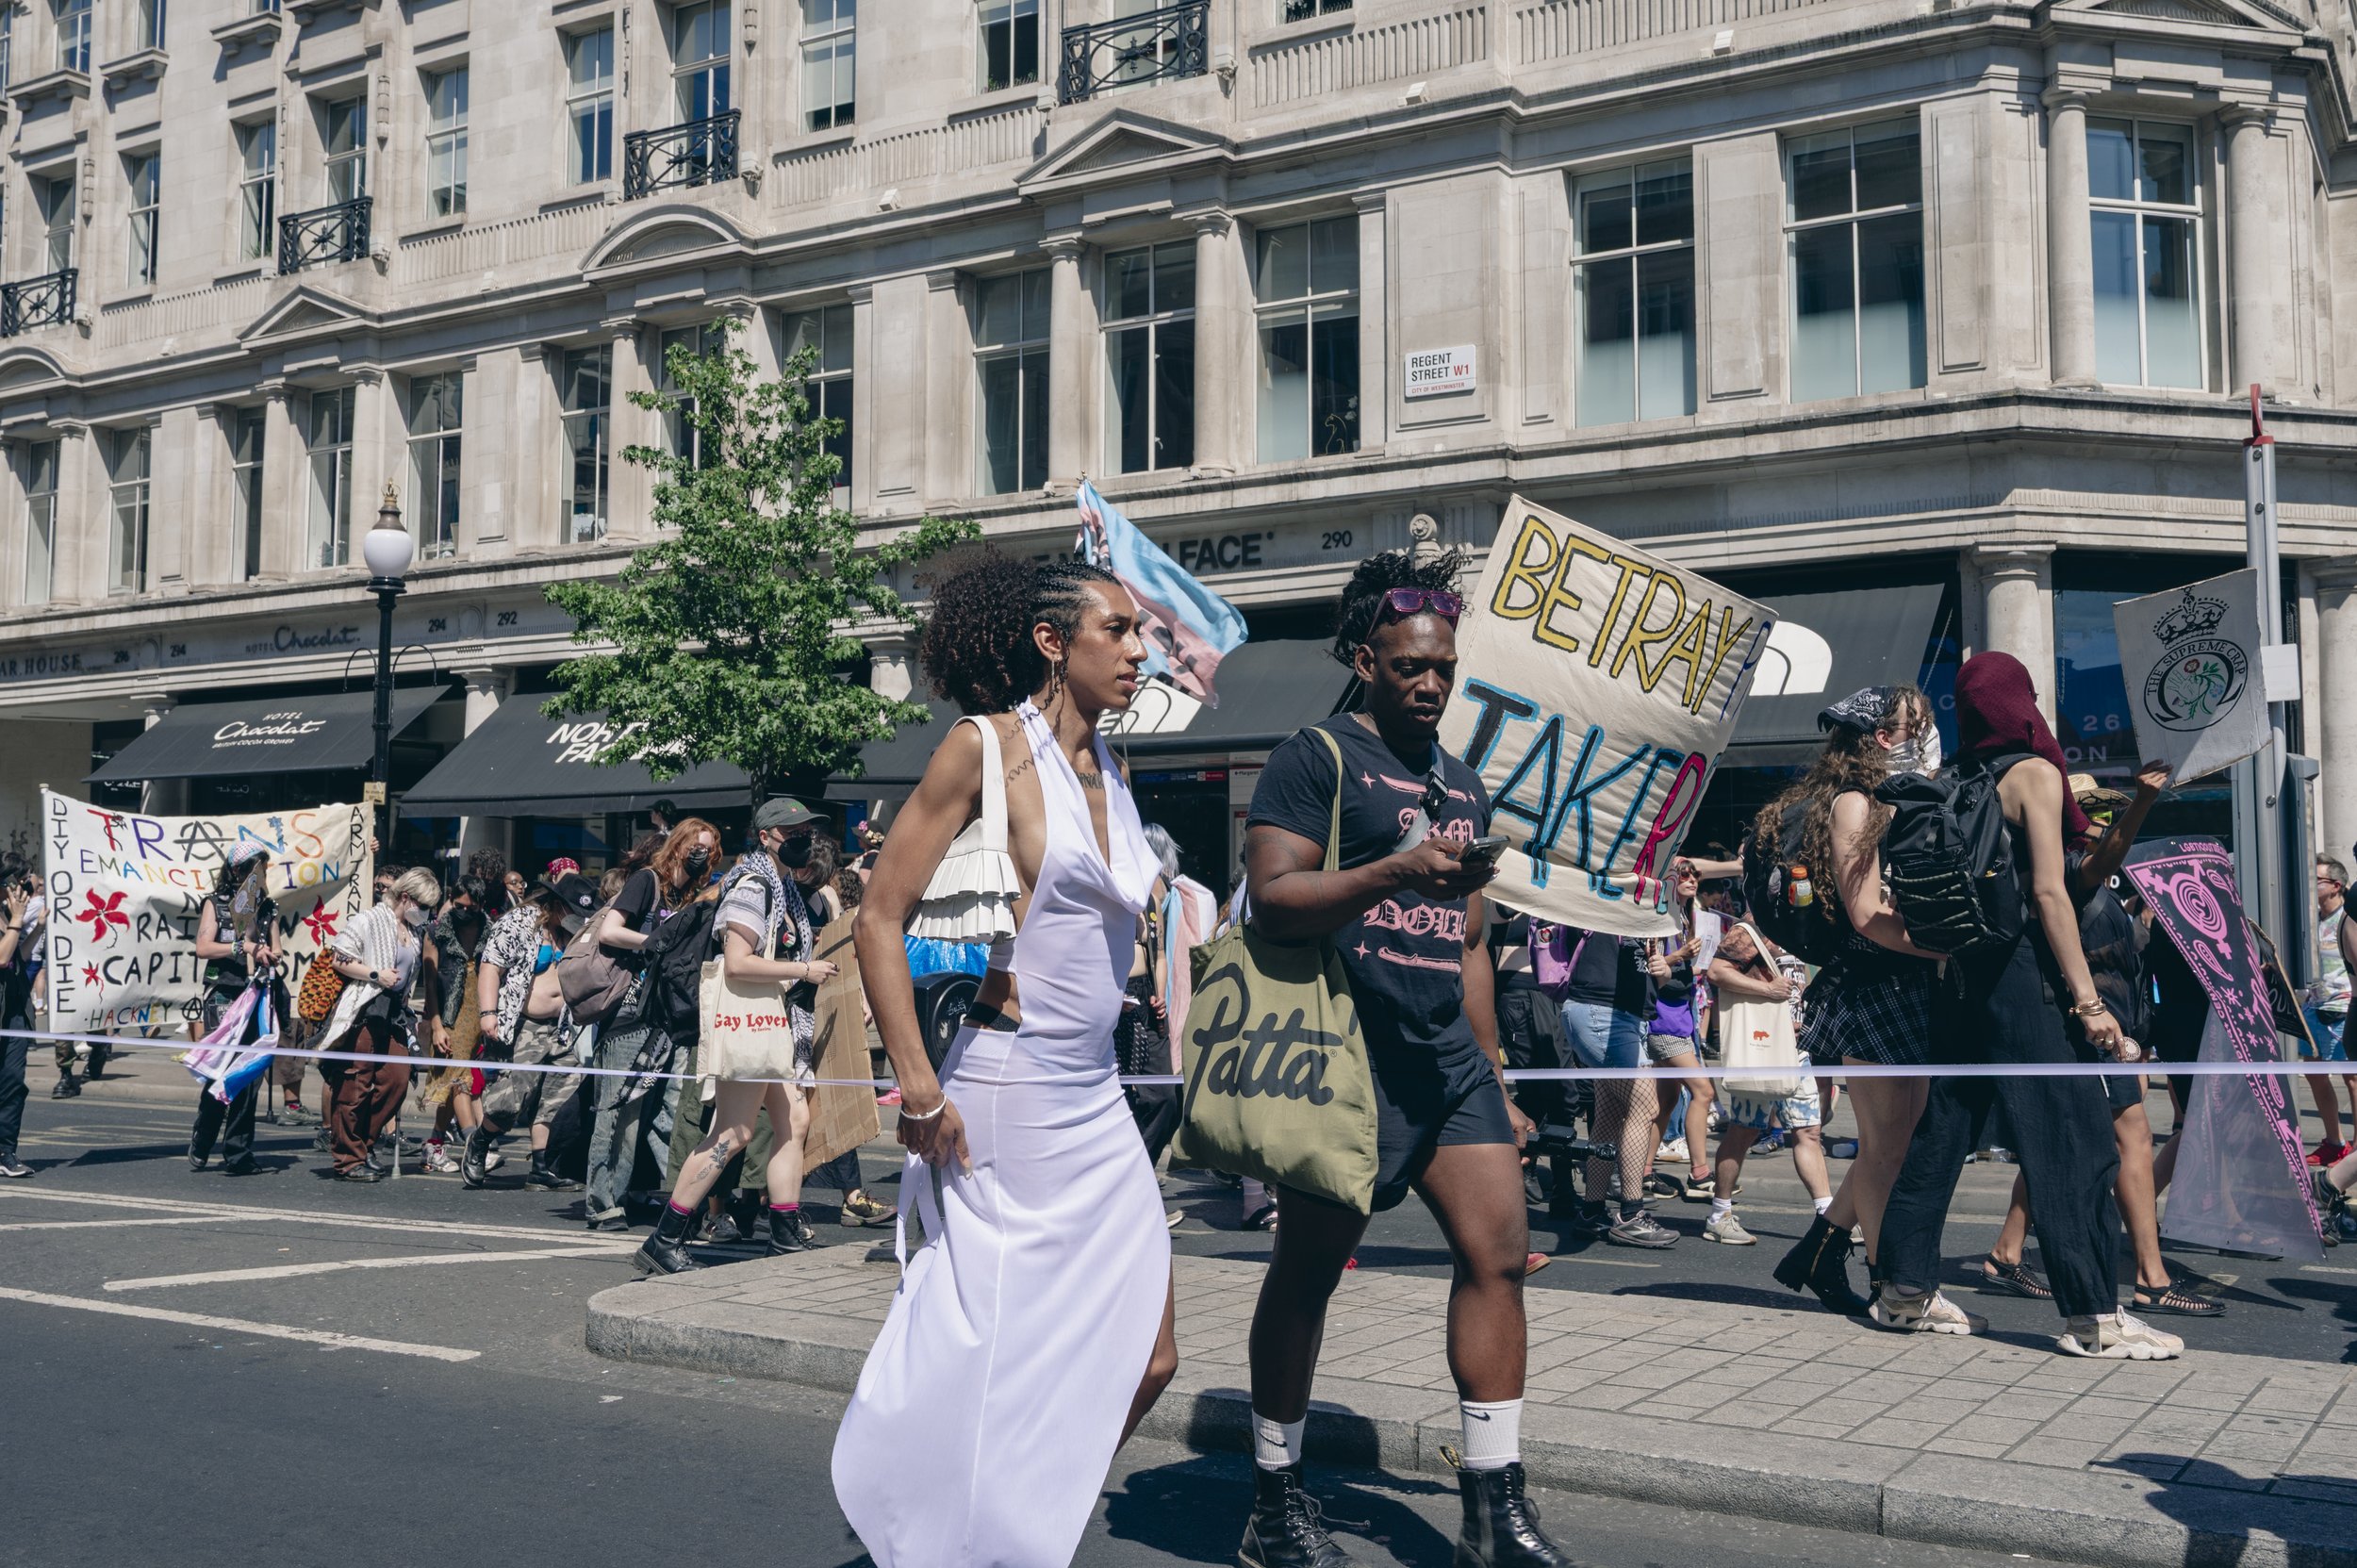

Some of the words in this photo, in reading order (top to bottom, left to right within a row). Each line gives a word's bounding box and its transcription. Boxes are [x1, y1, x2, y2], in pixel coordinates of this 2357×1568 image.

[1411, 353, 1452, 368] REGENT
[1411, 367, 1450, 382] STREET
[1454, 364, 1469, 376] W1
[1431, 382, 1465, 391] WESTMINSTER
[1178, 533, 1261, 570] FACE
[1322, 530, 1352, 550] 290
[428, 619, 446, 633] 294
[497, 611, 518, 626] 292
[1490, 515, 1754, 716] BETRAY
[170, 643, 187, 658] 294
[245, 642, 273, 654] HOTEL
[25, 653, 81, 675] HOUSE
[2148, 668, 2164, 696] THE
[2163, 641, 2228, 667] SUPREME
[2226, 648, 2246, 674] CRAP
[263, 712, 303, 721] HOTEL
[51, 798, 69, 860] DIY
[87, 809, 324, 863] TRANS
[350, 805, 367, 857] ARM
[51, 870, 74, 924] OR
[1363, 898, 1467, 943] DOLL
[54, 935, 76, 1014] DIE
[90, 1000, 173, 1030] HACKNEY
[715, 1014, 741, 1032] Gay
[746, 1013, 788, 1028] Lover
[1184, 963, 1343, 1128] Patta
